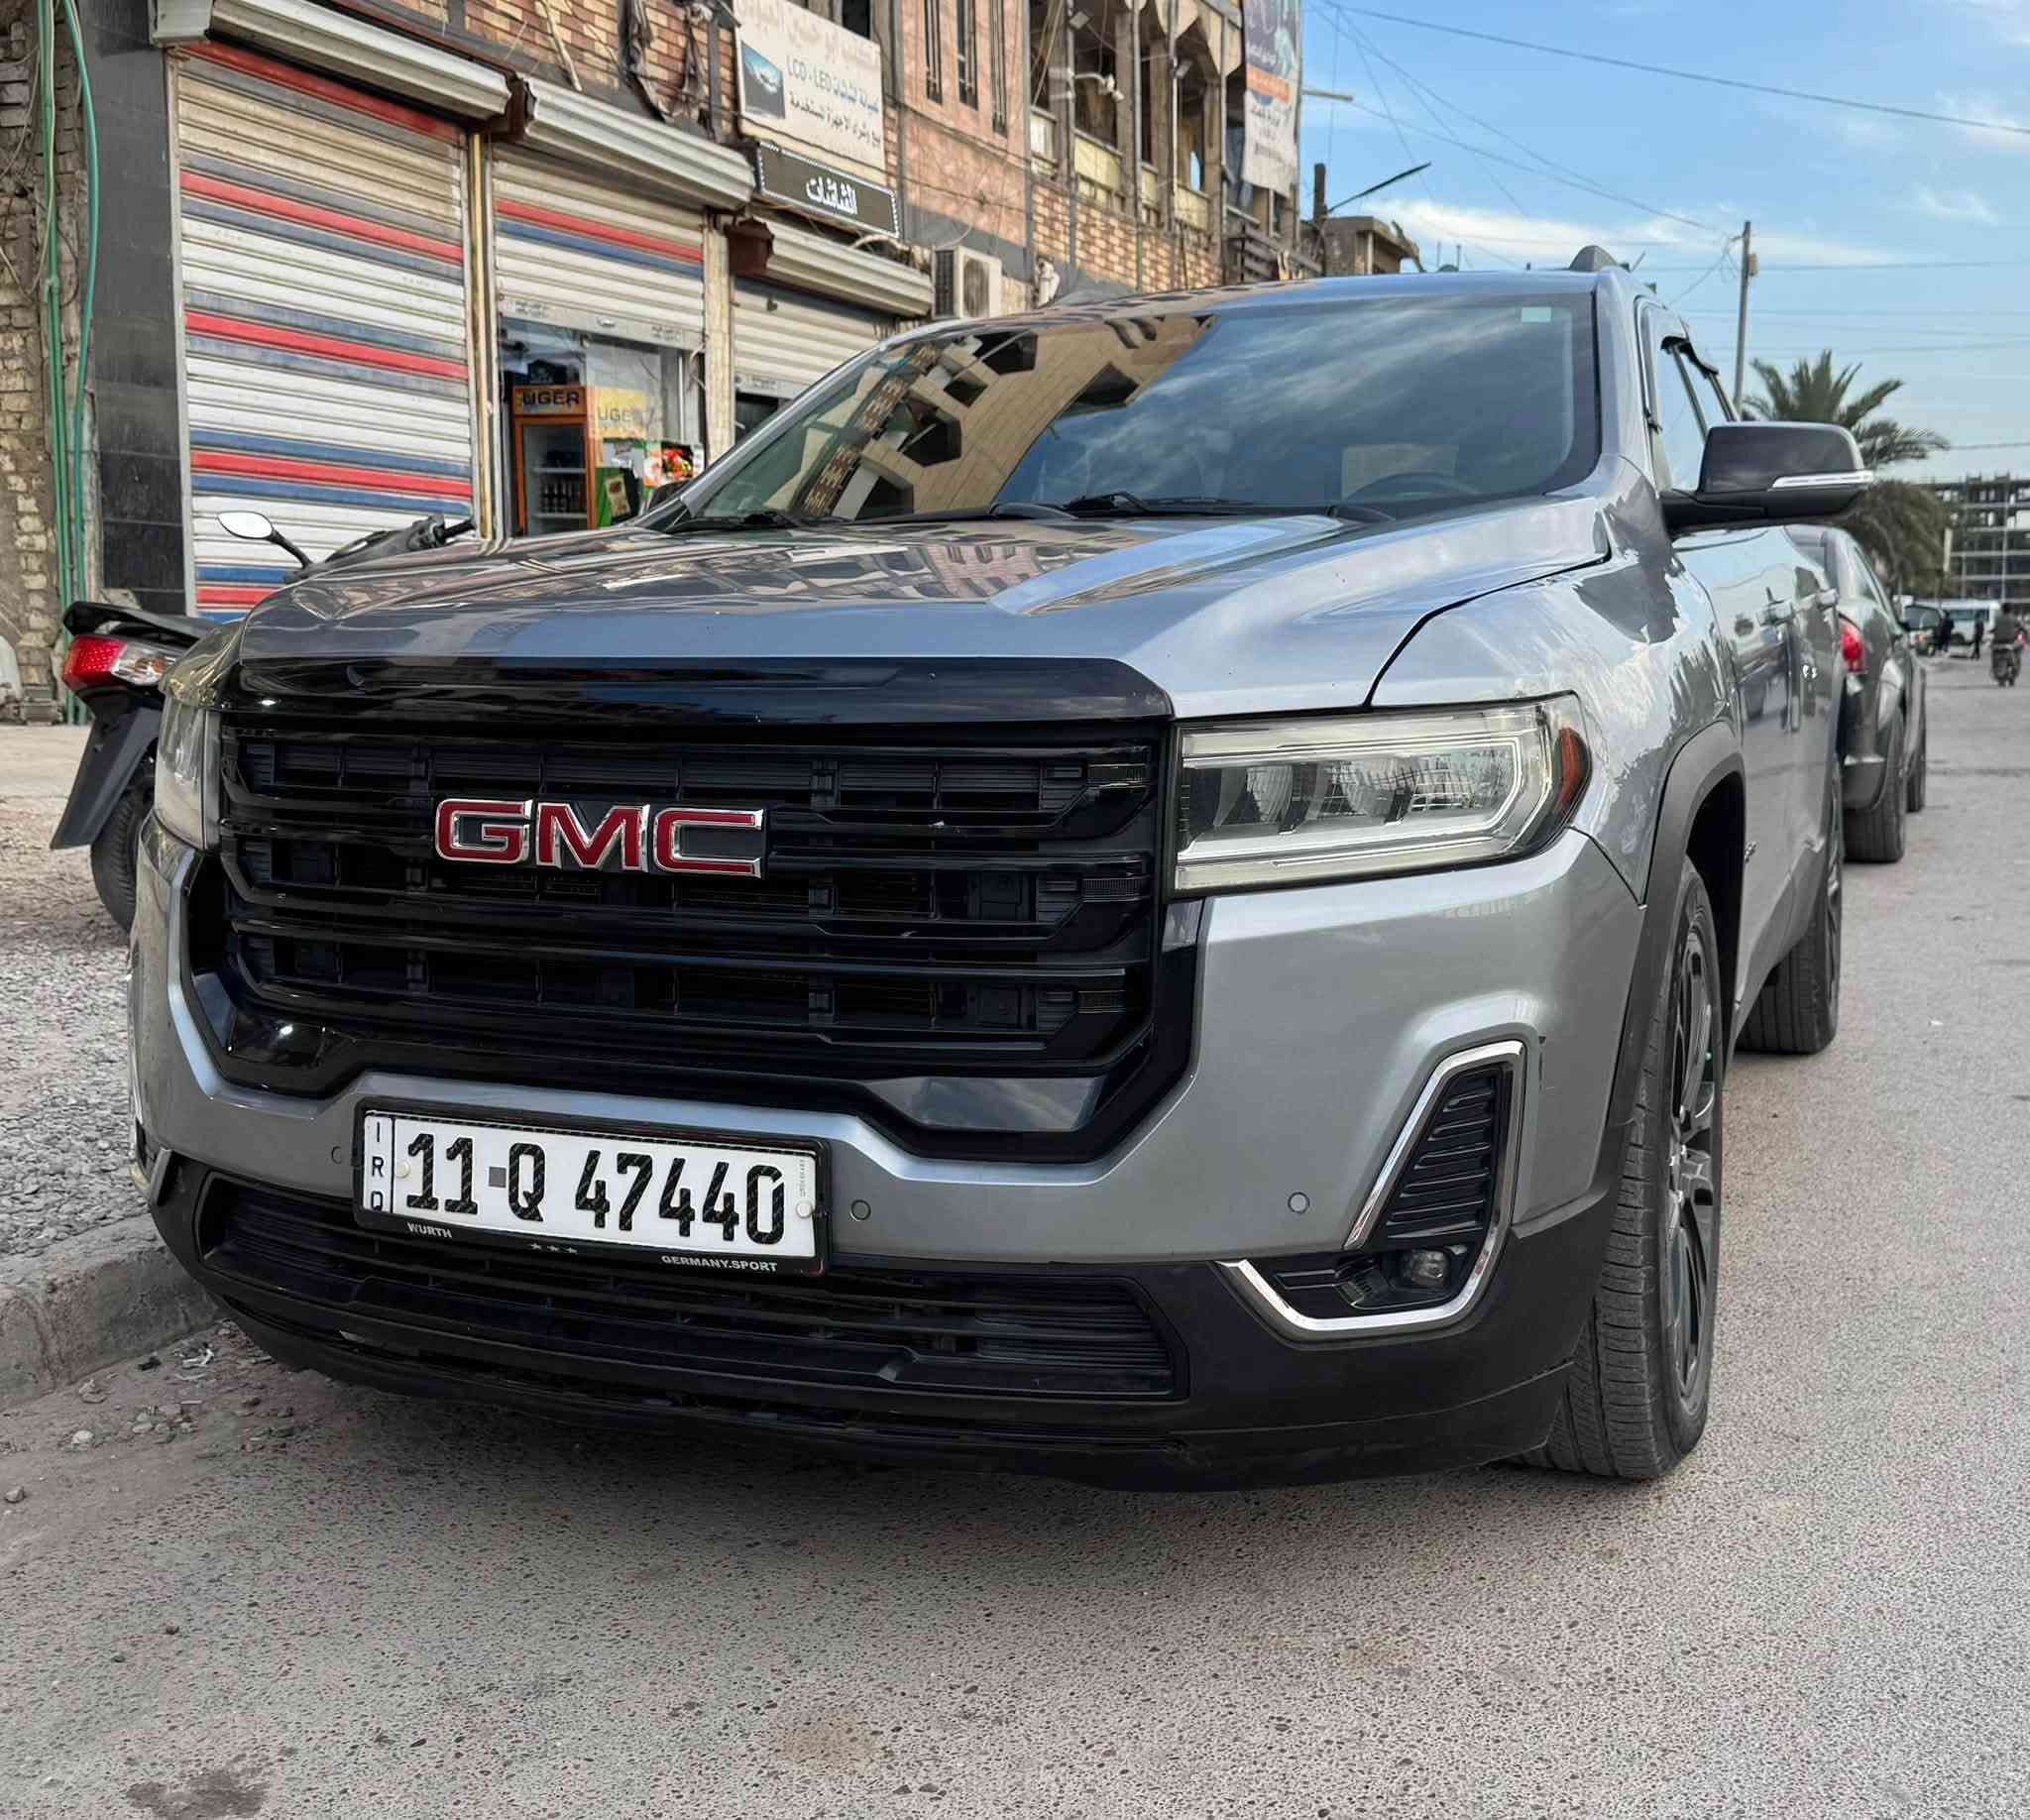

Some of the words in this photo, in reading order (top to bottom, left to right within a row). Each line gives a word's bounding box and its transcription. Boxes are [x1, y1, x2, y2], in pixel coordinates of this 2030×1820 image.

[434, 798, 765, 879] GMC
[406, 1132, 479, 1215] 11
[508, 1142, 546, 1222] Q
[574, 1149, 785, 1245] 47440
